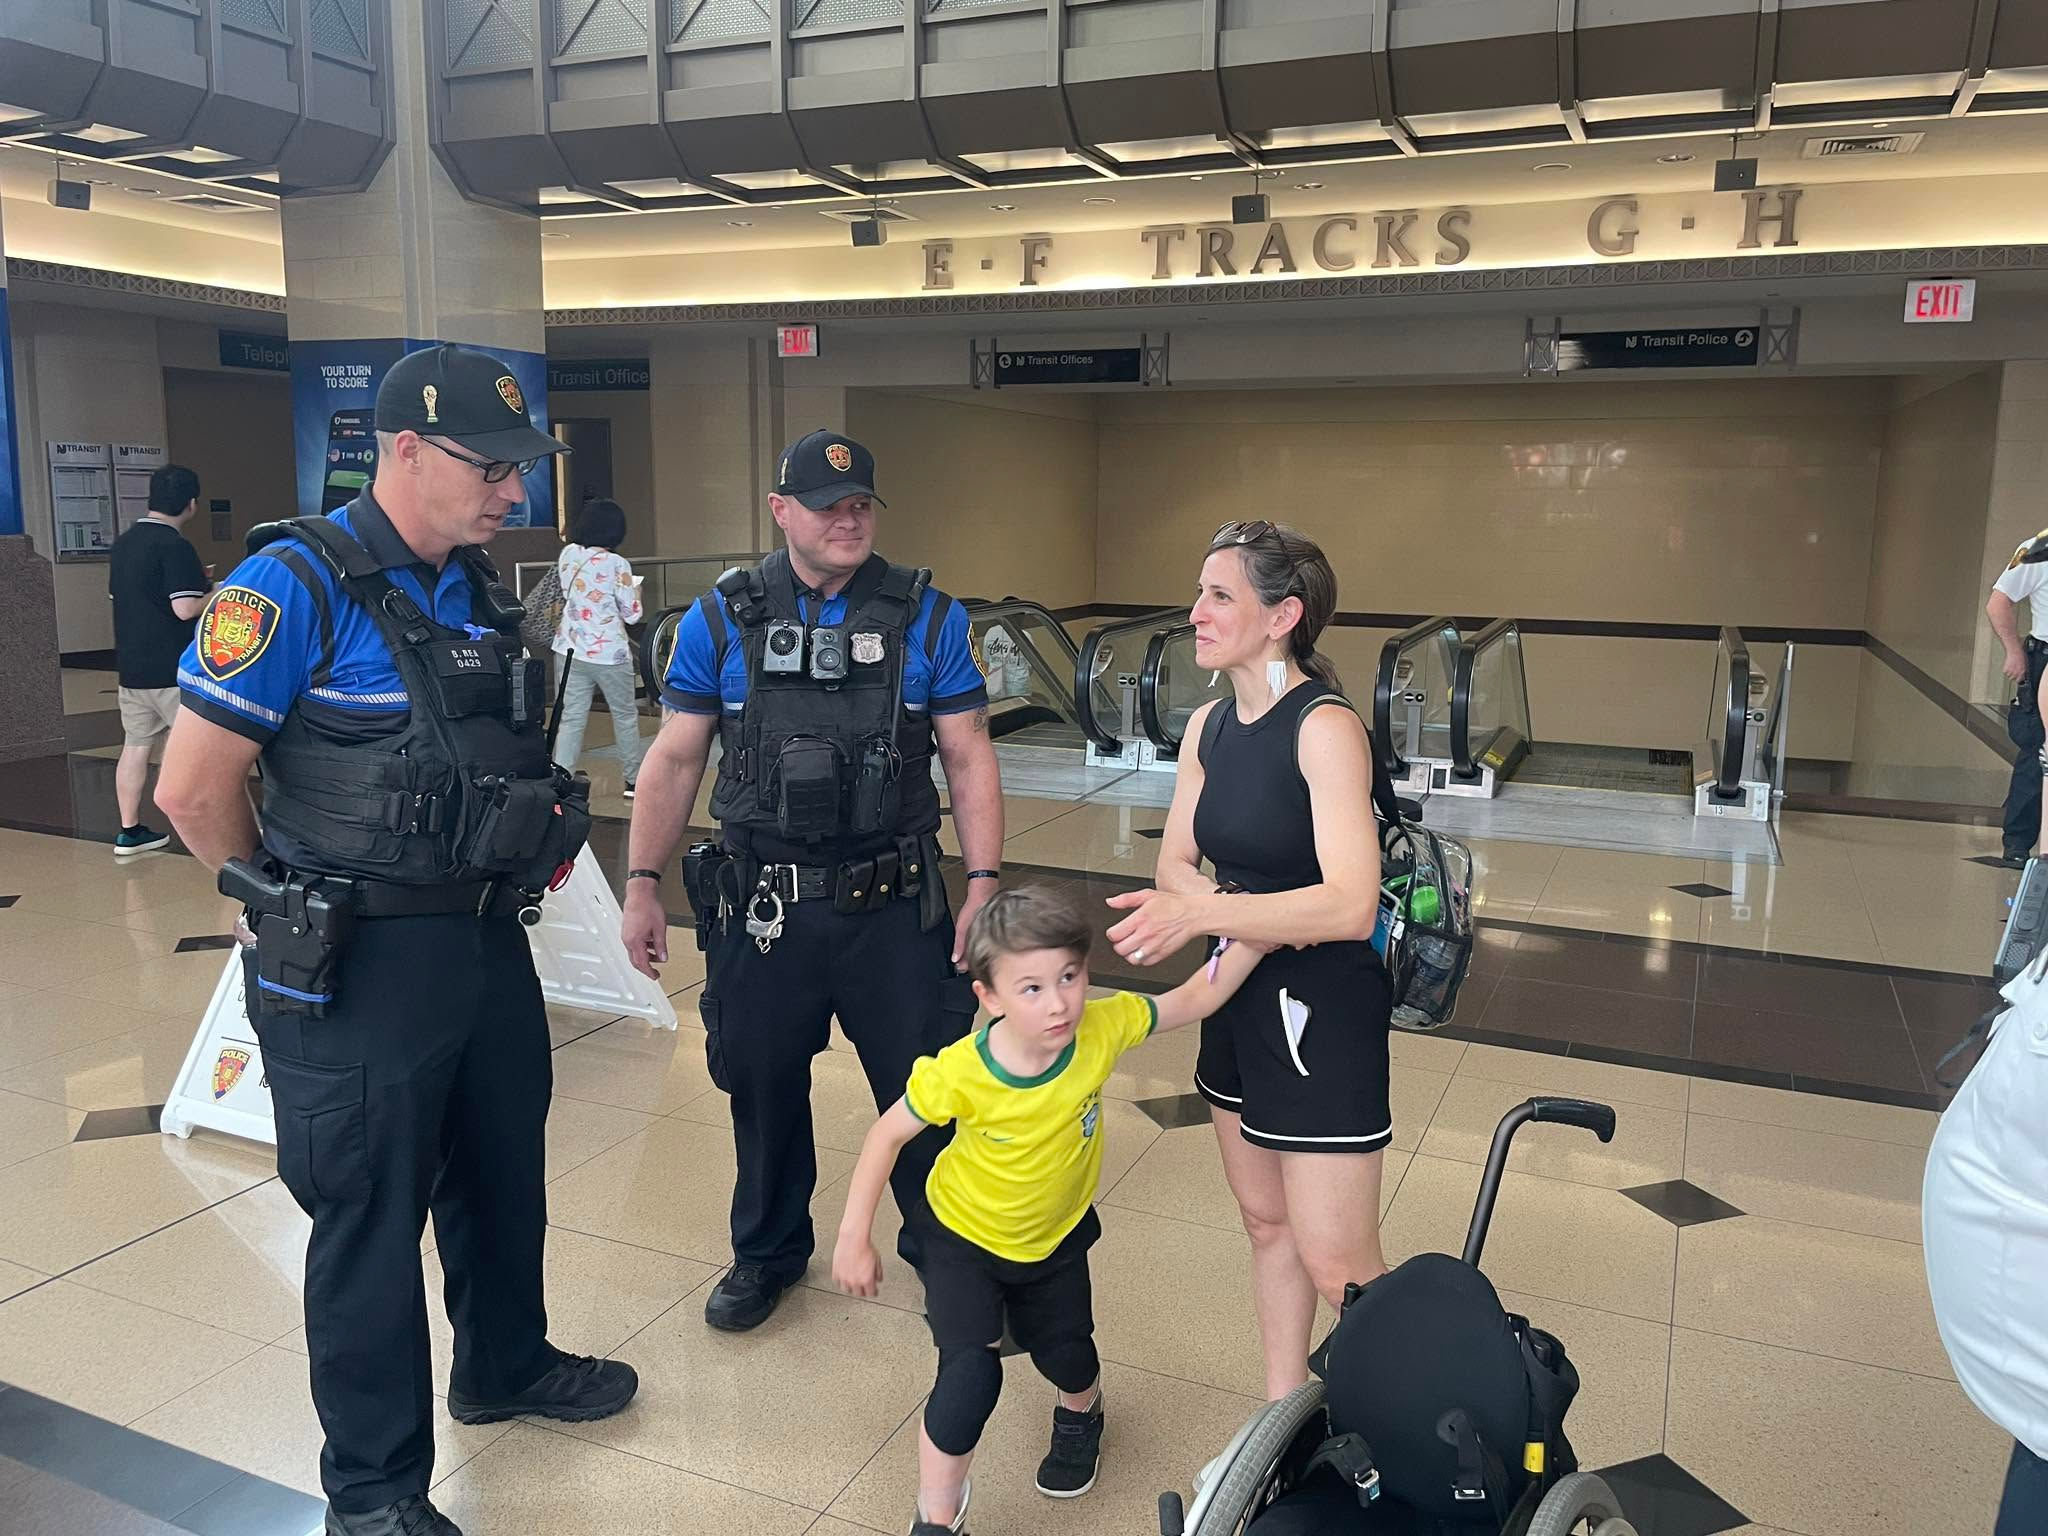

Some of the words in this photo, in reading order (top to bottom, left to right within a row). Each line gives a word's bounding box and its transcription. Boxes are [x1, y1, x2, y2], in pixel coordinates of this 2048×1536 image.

[922, 243, 954, 291] E
[1019, 238, 1054, 286] F
[1140, 210, 1472, 281] TRACKS
[1586, 199, 1640, 257] G
[1736, 189, 1803, 249] H
[1915, 284, 1964, 320] EXIT
[783, 328, 810, 353] EXIT
[1642, 335, 1684, 347] Transit
[1688, 333, 1728, 346] Police
[1027, 355, 1058, 366] Transit
[1060, 354, 1094, 365] Offices
[320, 365, 345, 377] YOUR
[346, 364, 372, 376] TURN
[549, 369, 601, 385] Transit
[605, 367, 649, 385] Office
[325, 377, 338, 389] TO
[339, 377, 369, 389] SCORE
[68, 444, 101, 454] TRANSIT
[129, 446, 161, 455] TRANSIT
[217, 590, 268, 616] POLICE
[204, 612, 215, 633] NEW
[203, 632, 213, 658] JERSEY
[236, 632, 264, 663] TRANSIT
[1715, 806, 1723, 815] 13
[221, 1050, 248, 1064] POLICE
